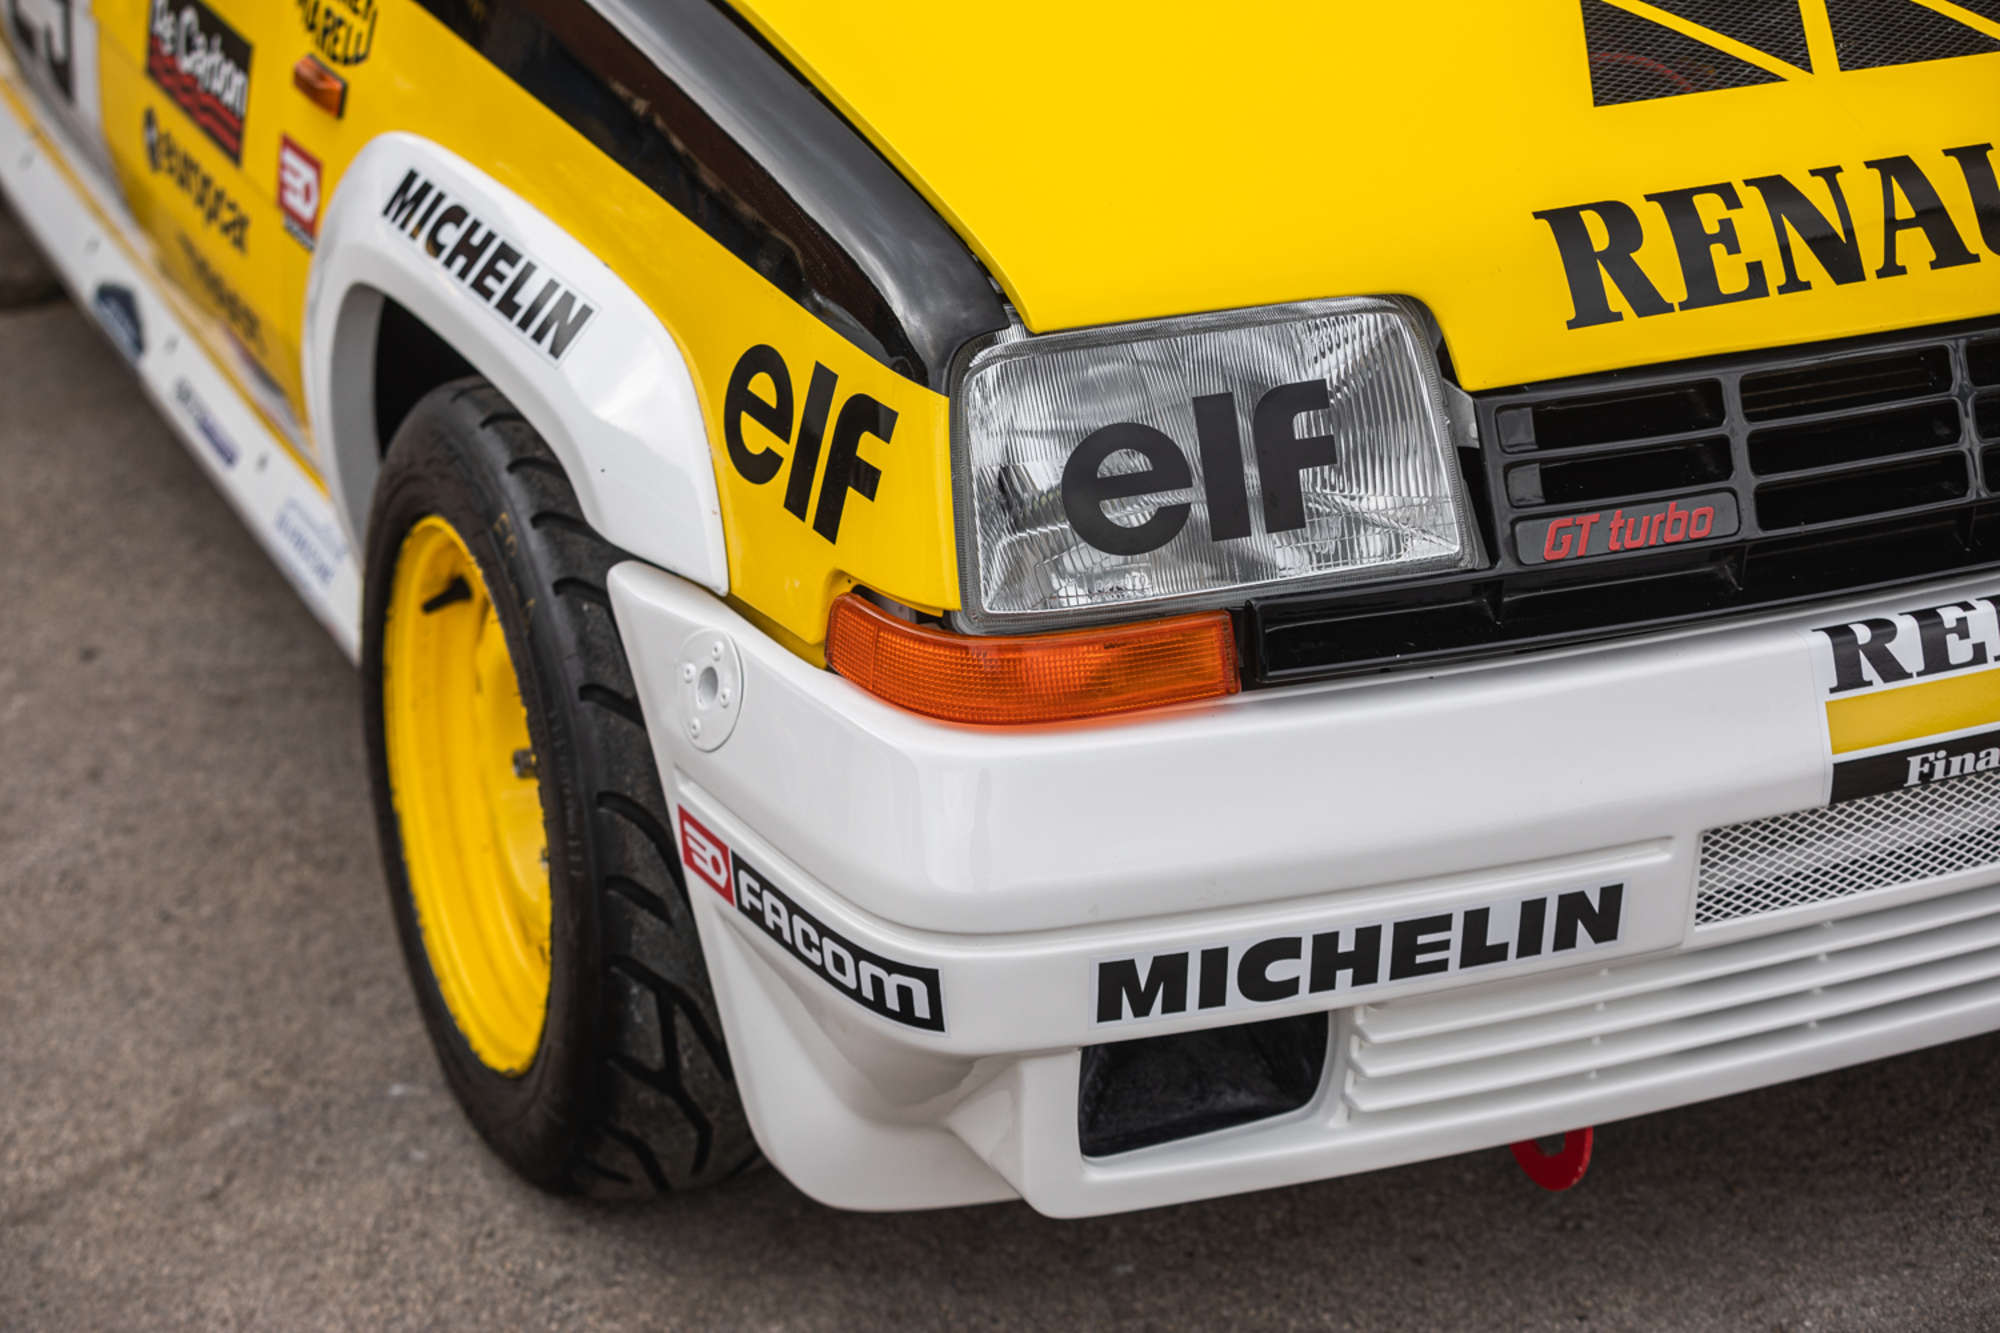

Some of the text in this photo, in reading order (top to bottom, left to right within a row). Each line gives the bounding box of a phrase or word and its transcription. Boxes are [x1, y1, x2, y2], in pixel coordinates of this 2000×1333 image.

[381, 168, 594, 360] MICHELIN
[724, 344, 899, 545] elf
[1061, 378, 1338, 556] elf
[1544, 501, 1714, 560] GT turbo
[1811, 594, 2000, 693] RE
[1097, 883, 1624, 1023] MICHELIN
